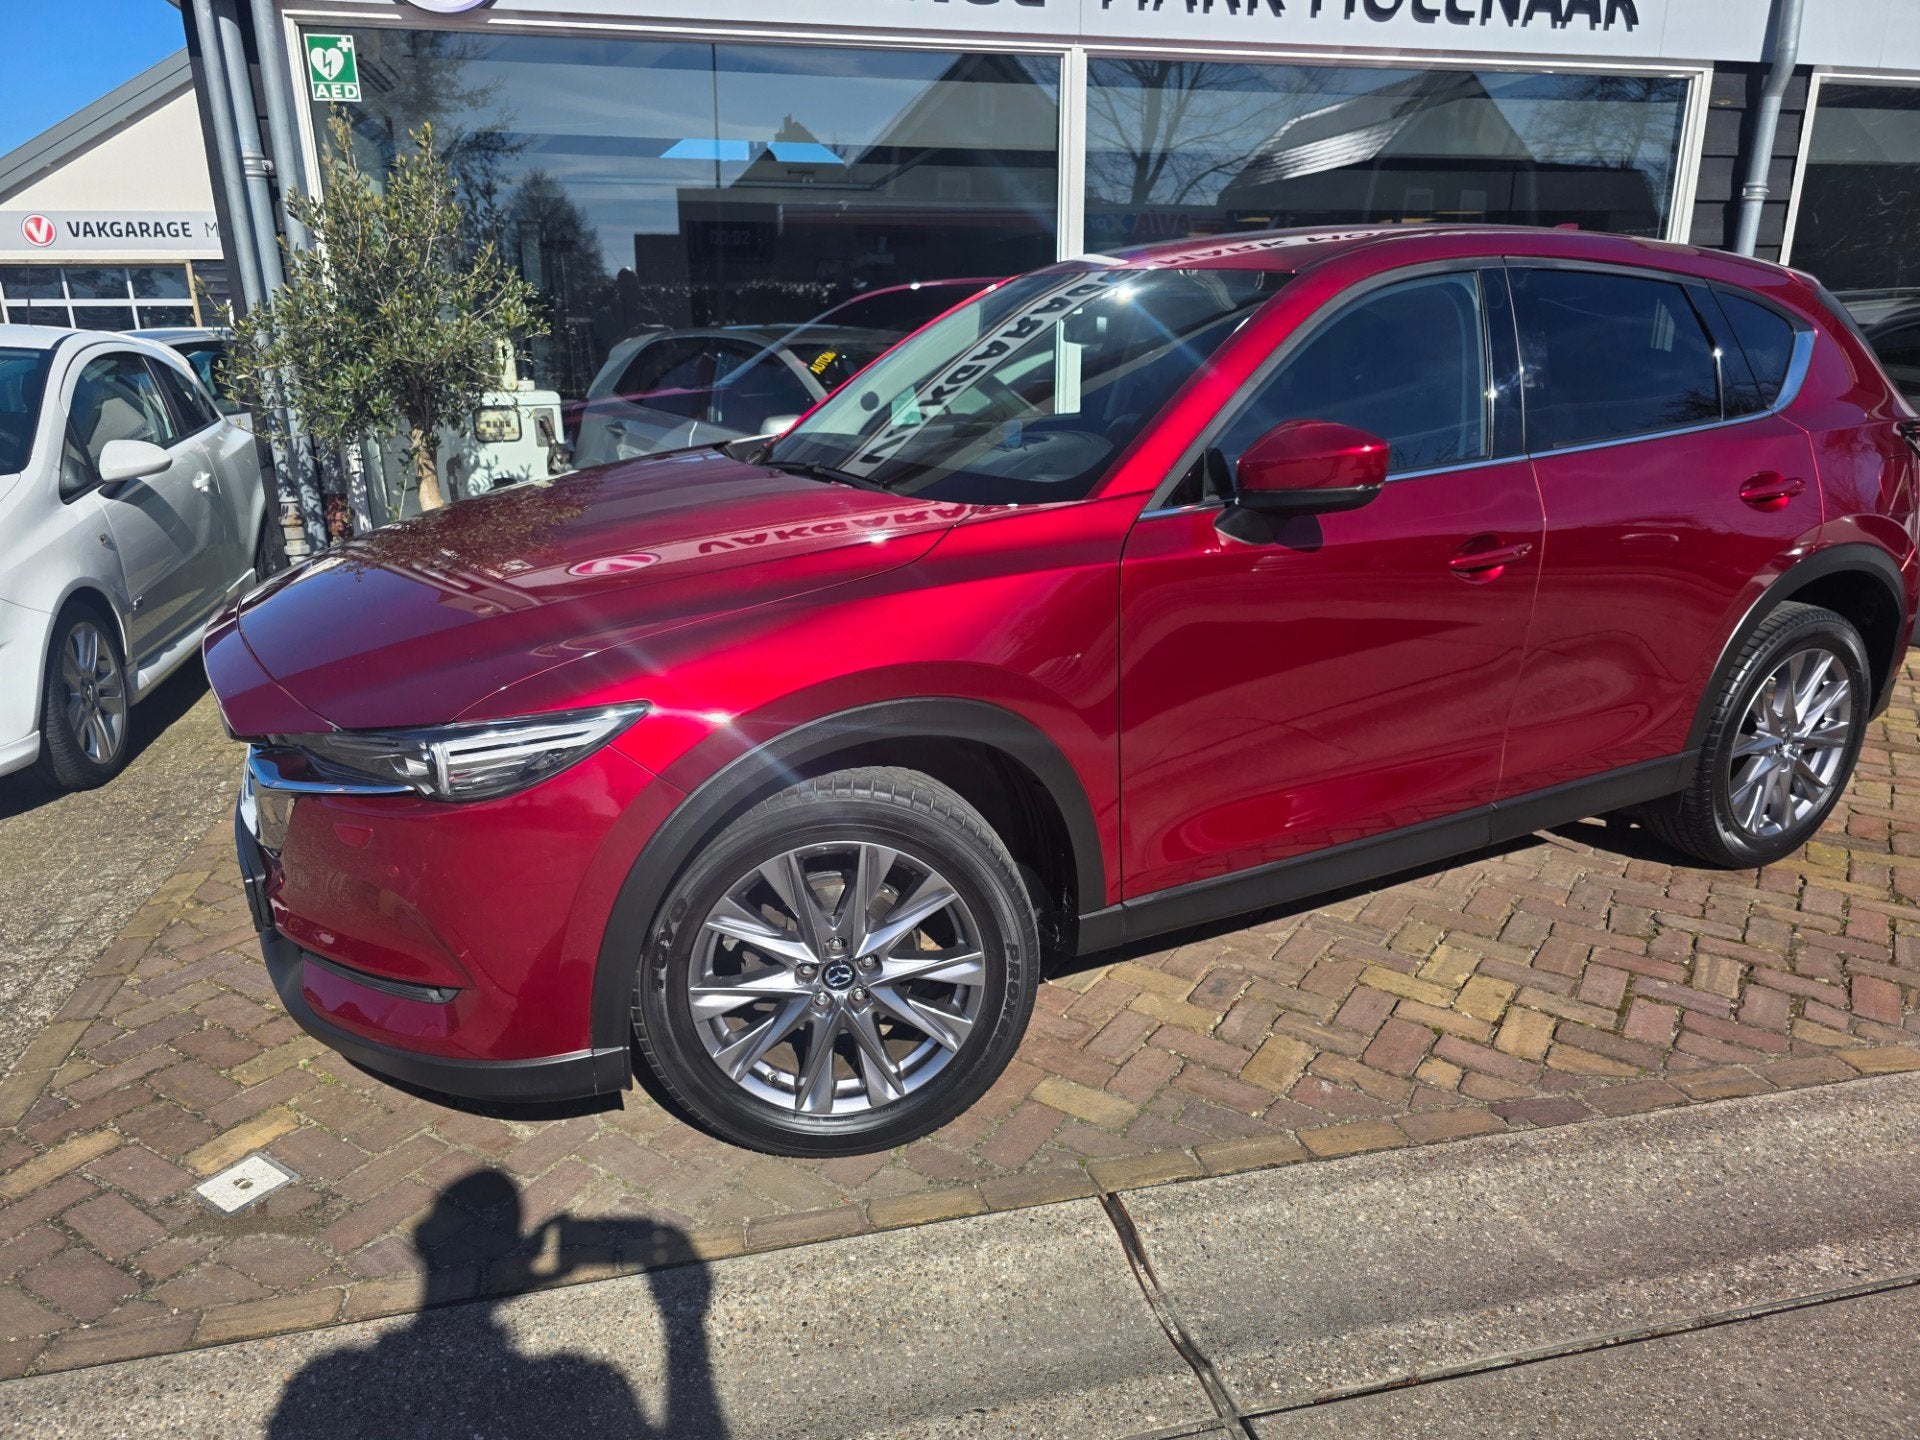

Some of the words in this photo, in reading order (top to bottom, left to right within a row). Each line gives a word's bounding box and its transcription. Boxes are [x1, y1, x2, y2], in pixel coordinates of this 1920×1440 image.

[315, 84, 358, 98] AED
[66, 221, 192, 238] VAKGARAGE
[204, 221, 220, 238] M
